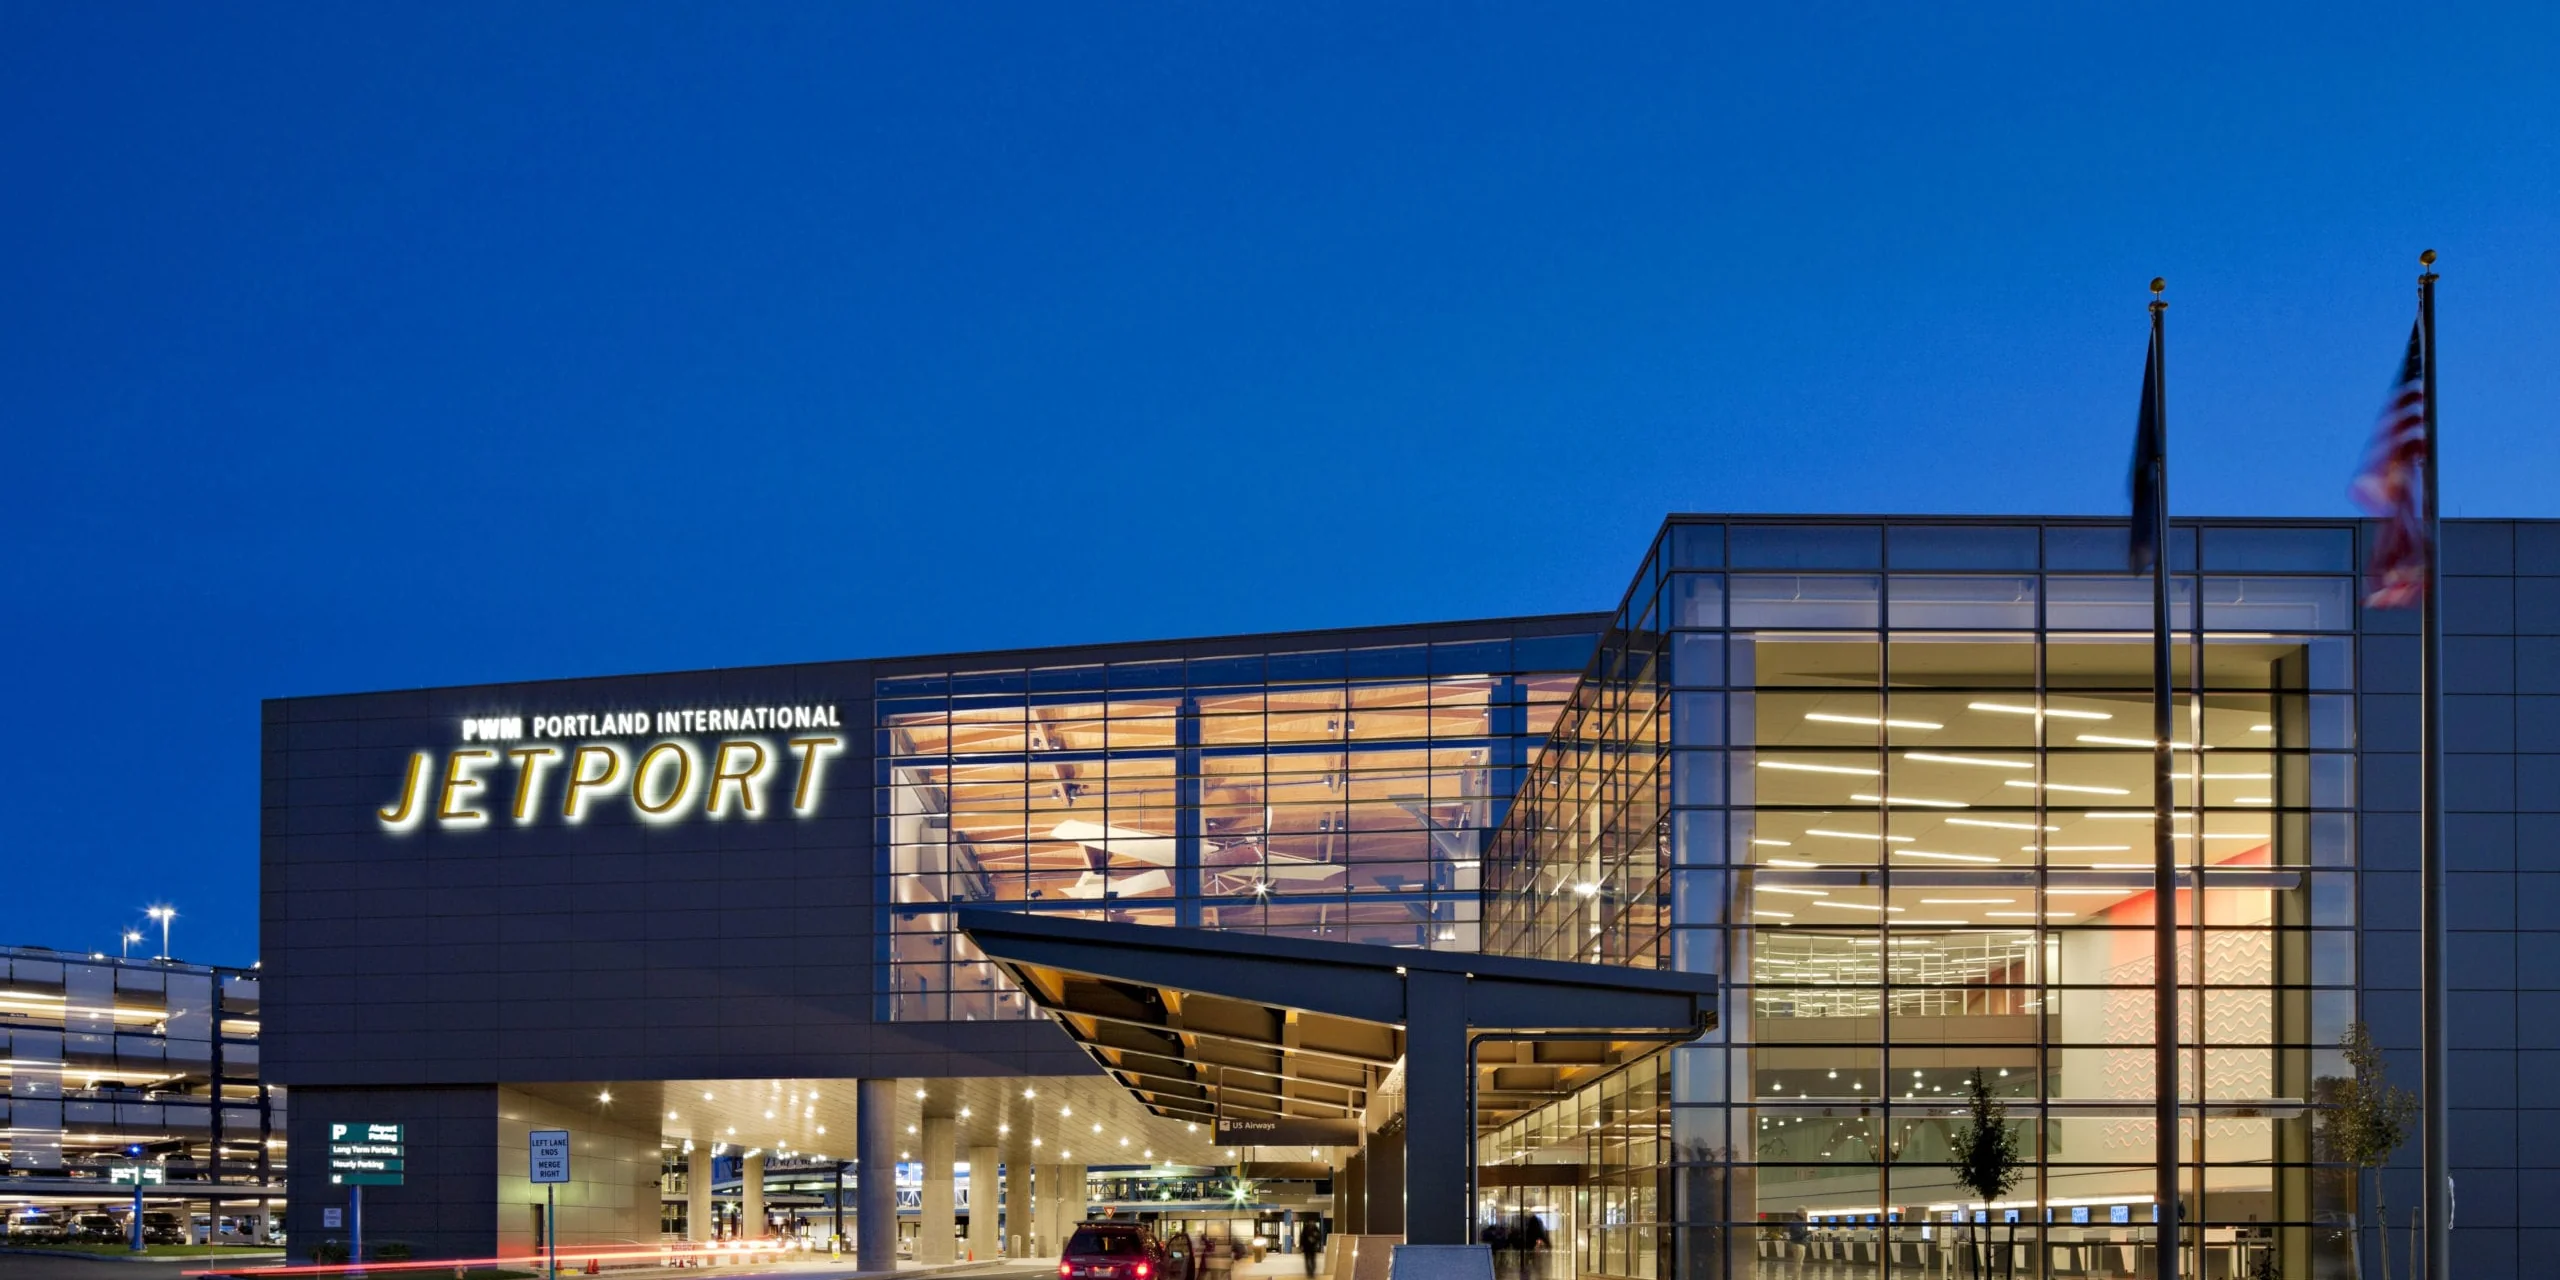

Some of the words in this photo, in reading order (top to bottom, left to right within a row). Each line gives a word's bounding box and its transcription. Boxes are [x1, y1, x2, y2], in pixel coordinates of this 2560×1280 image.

[463, 717, 521, 741] PWM
[533, 712, 650, 738] PORTLAND
[656, 705, 841, 733] INTERNATIONAL
[377, 737, 841, 825] JETPORT
[1245, 1122, 1276, 1131] Airways
[332, 1124, 347, 1140] P
[532, 1139, 548, 1147] LEFT
[550, 1139, 567, 1147] LANE
[333, 1146, 351, 1155] Long
[371, 1146, 398, 1155] Parking
[333, 1161, 356, 1169] Hourly
[357, 1161, 384, 1170] Parking
[539, 1161, 561, 1169] MERGE
[540, 1170, 560, 1178] RIGHT
